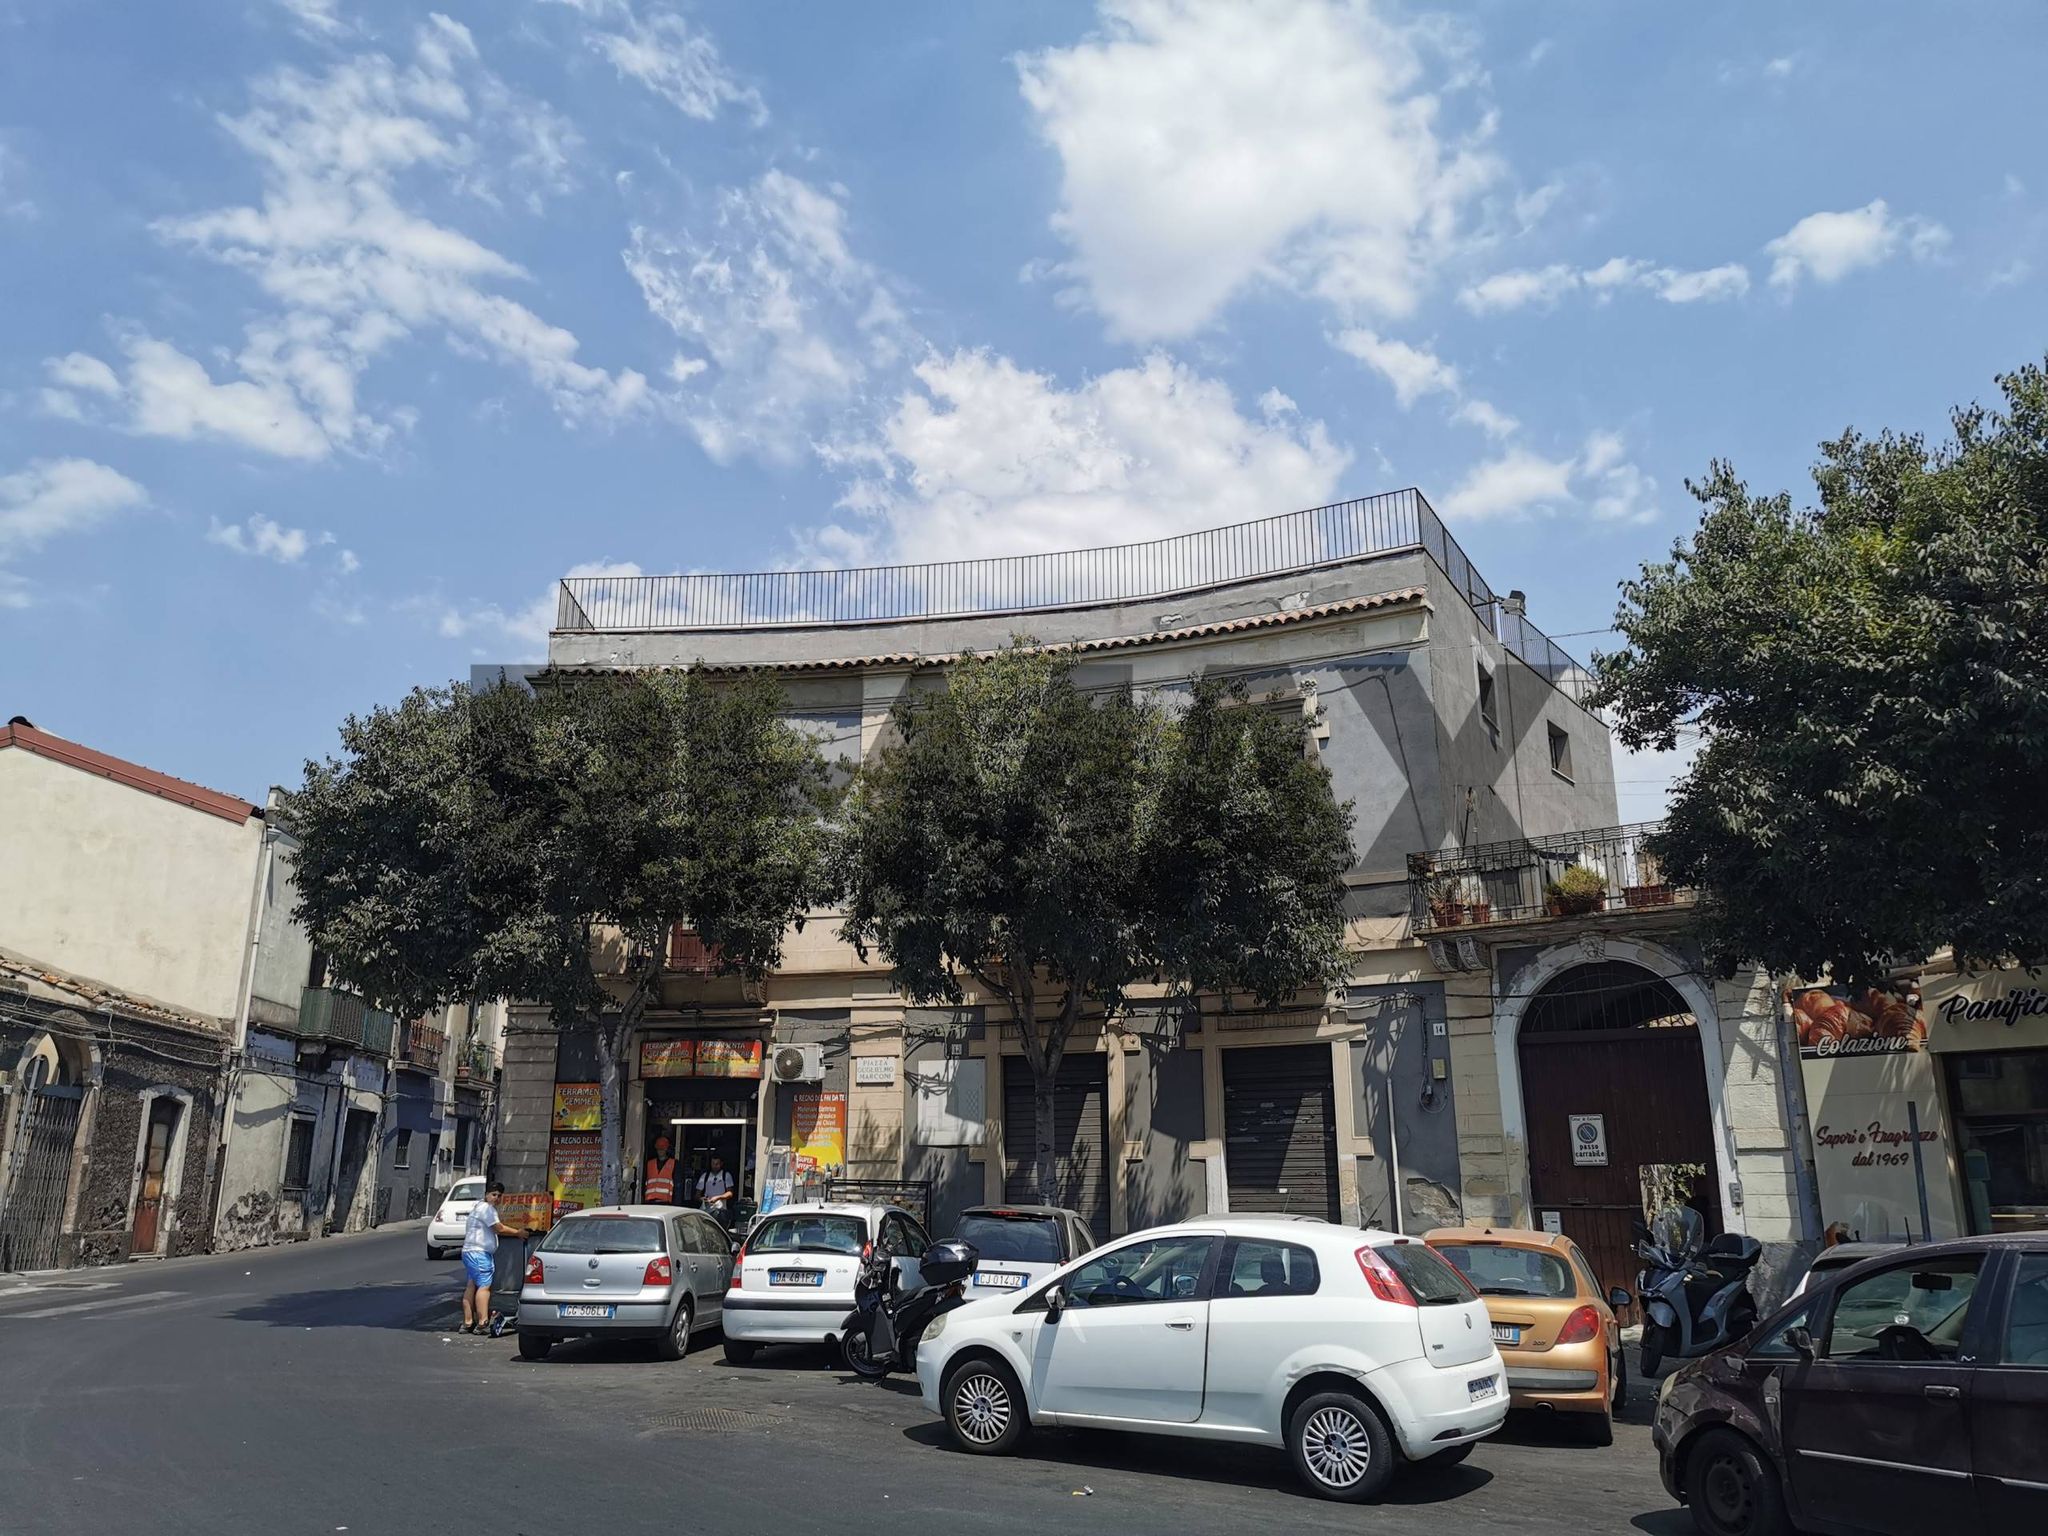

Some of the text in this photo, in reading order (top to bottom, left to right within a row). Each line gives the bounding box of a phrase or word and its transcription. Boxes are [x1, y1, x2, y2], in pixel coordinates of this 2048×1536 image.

[1816, 1032, 1909, 1056] Colazione
[560, 1088, 600, 1096] FERRAMEN
[565, 1097, 600, 1105] GEMMELL
[554, 1136, 560, 1145] IL
[561, 1136, 581, 1145] REGNO
[583, 1136, 593, 1145] DEL
[1817, 1126, 1857, 1149] Sapori
[1859, 1133, 1867, 1144] e
[1575, 1150, 1605, 1158] carrabile
[1852, 1151, 1909, 1166] dal 1969
